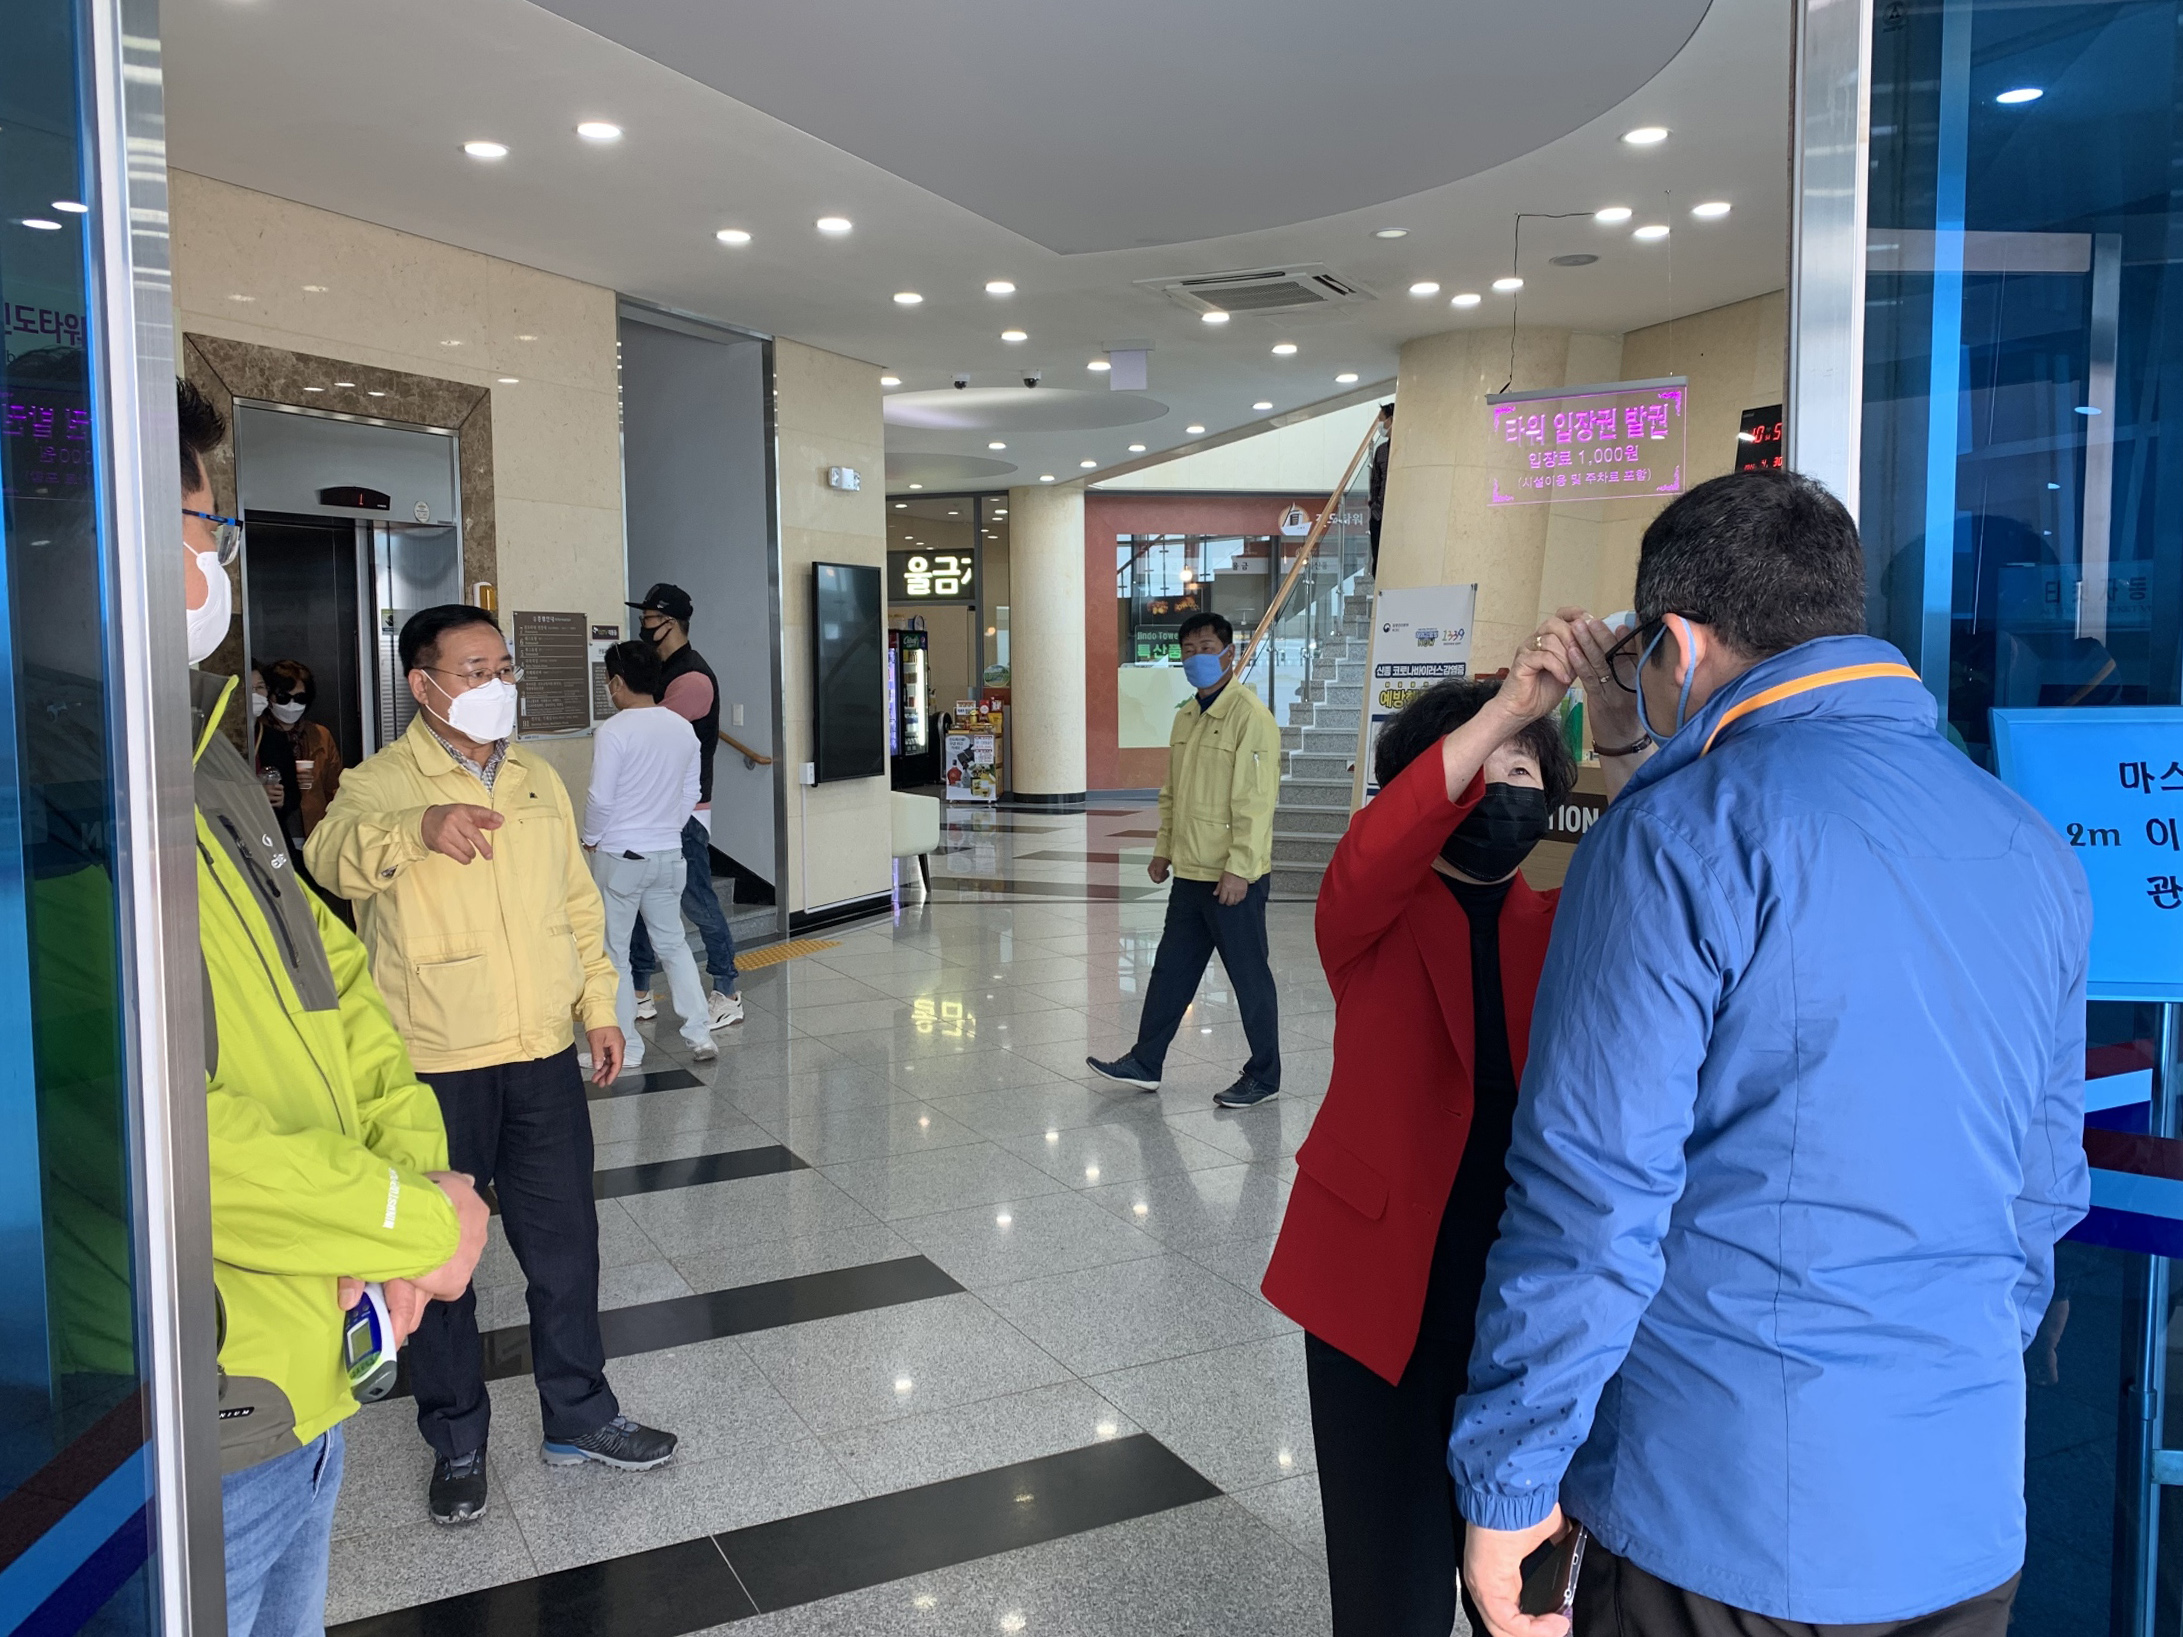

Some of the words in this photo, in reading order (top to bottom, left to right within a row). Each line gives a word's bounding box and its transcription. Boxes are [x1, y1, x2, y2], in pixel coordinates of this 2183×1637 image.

[1505, 414, 1546, 447] 타워
[1553, 408, 1617, 444] 입장권
[1625, 403, 1668, 439] 발권
[1529, 450, 1572, 469] 입장료
[1578, 444, 1639, 466] 1,000원
[1518, 474, 1567, 489] (시설이용
[1571, 472, 1581, 486] 및
[1623, 468, 1652, 483] 포함)
[1159, 631, 1179, 640] Towe
[1442, 628, 1465, 642] 1339
[1376, 666, 1392, 677] 신종
[1393, 664, 1465, 677] 코로나바이러스감염증
[2066, 823, 2121, 847] 2m
[2146, 818, 2180, 851] 이
[2146, 876, 2183, 910] 관
